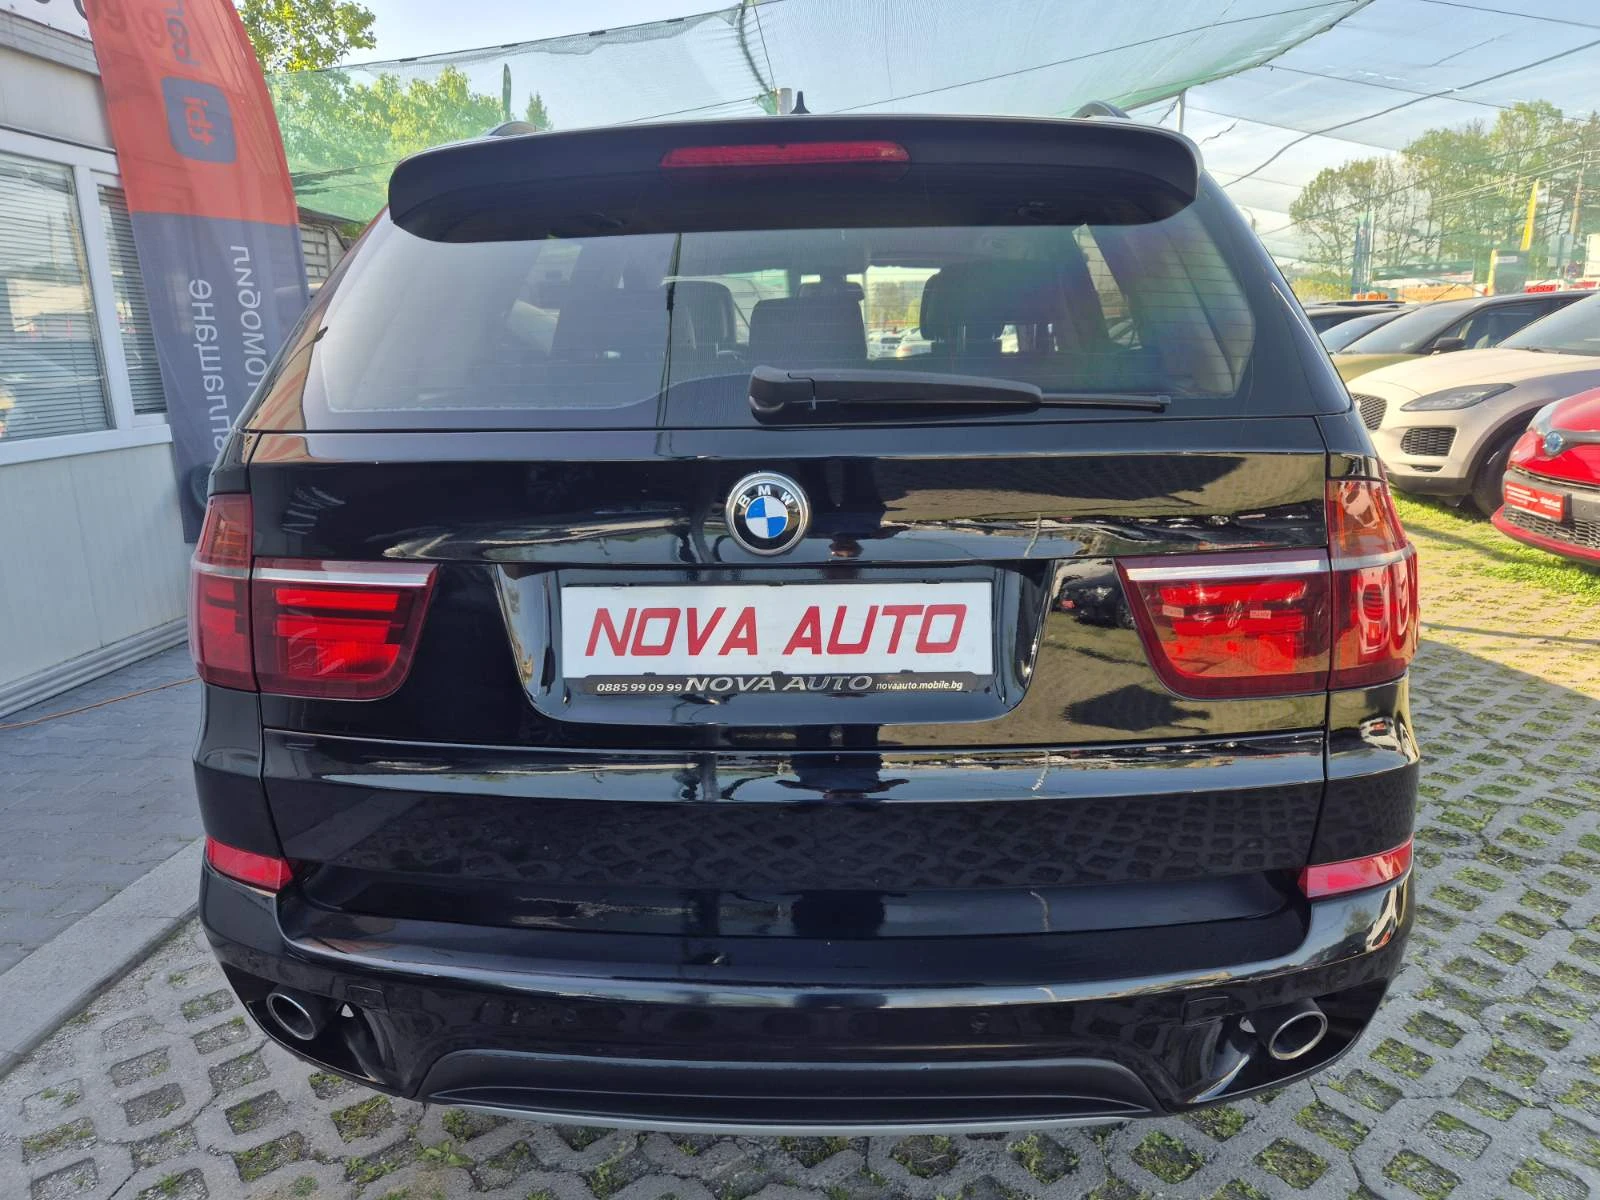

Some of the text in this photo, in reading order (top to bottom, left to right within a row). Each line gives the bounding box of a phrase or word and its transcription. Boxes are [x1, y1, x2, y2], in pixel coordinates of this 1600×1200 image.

[738, 485, 794, 508] BMW
[585, 604, 967, 656] NOVA AUTO
[596, 675, 963, 692] 0885 99 09 99 NOVA AUTO novaauto.mobile.bg
